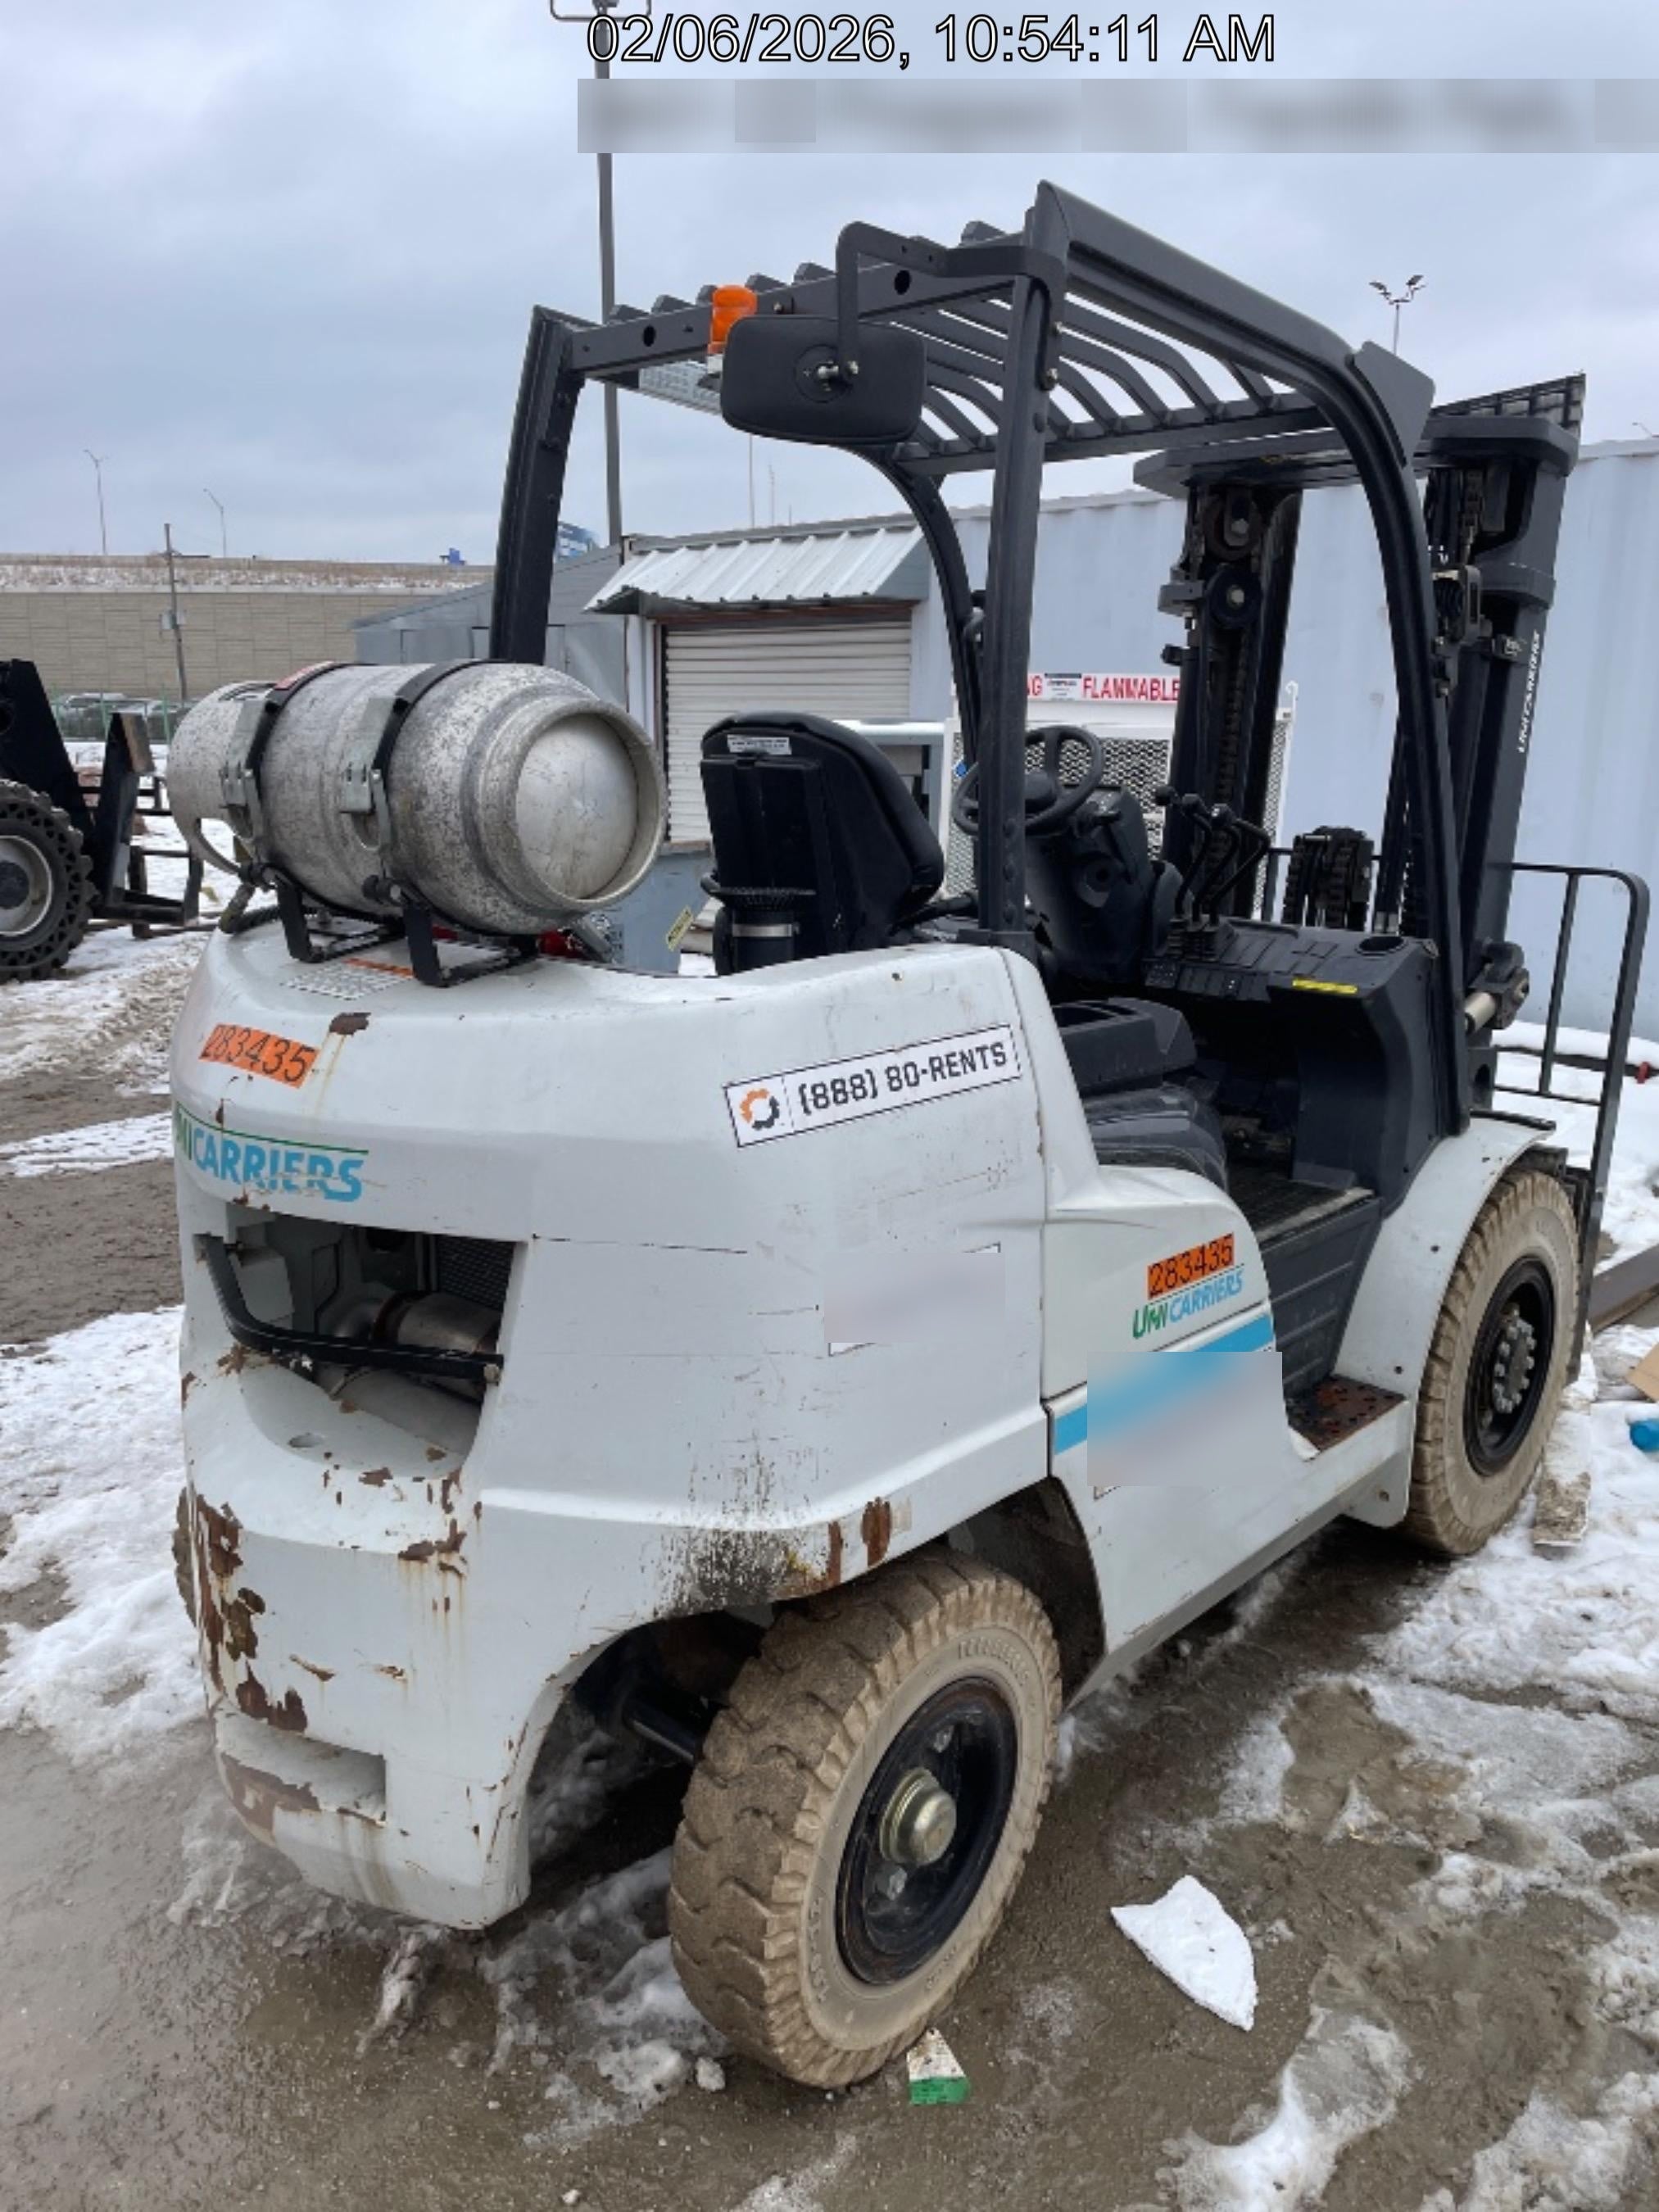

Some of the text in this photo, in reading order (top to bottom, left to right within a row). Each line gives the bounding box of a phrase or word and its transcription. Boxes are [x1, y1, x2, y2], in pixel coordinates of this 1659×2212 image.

[1083, 676, 1181, 701] FLAMMABLE
[200, 1024, 316, 1082] 283435
[798, 1041, 1007, 1115] (888) 80-RENTS
[176, 1108, 365, 1203] NICARRIERS
[1148, 1232, 1234, 1300] 283435
[1132, 1267, 1245, 1339] UNICARRIERS
